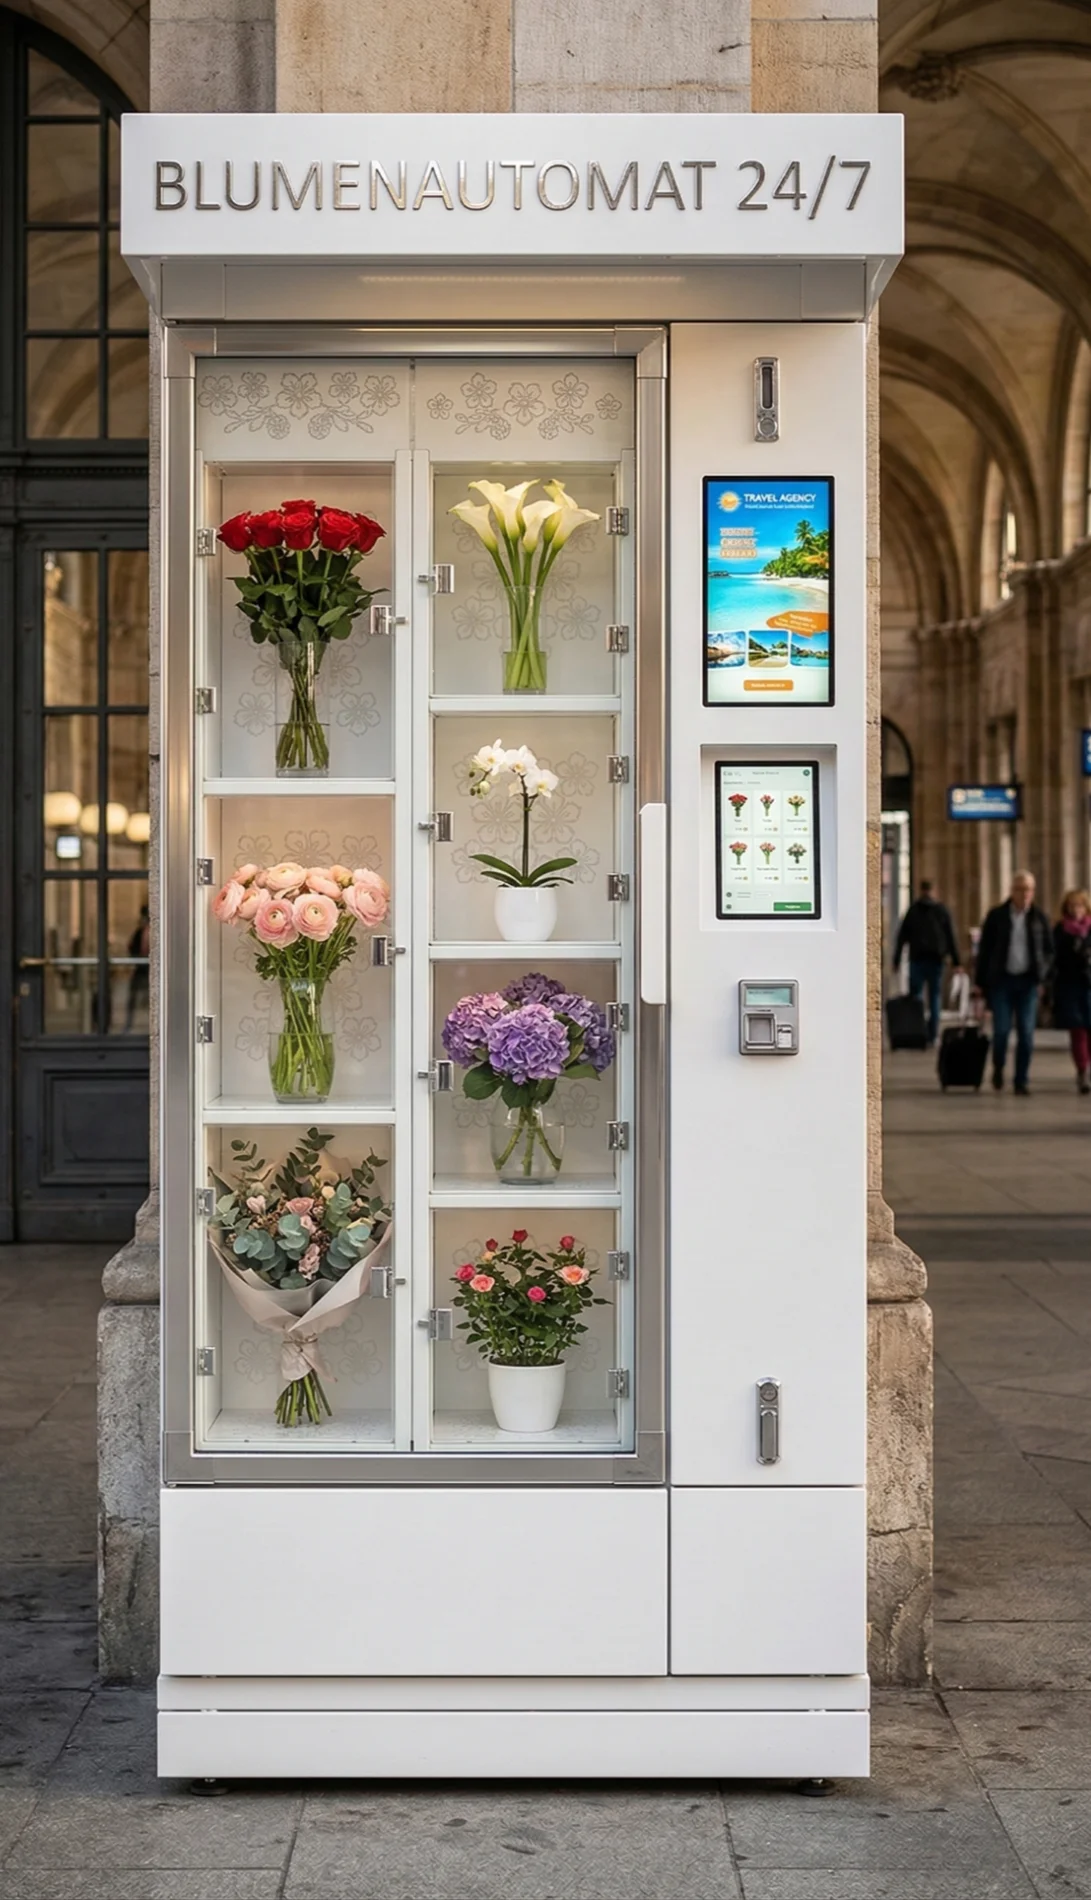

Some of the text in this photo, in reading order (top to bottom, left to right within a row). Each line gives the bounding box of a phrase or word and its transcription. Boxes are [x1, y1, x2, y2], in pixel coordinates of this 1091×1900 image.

[154, 154, 874, 220] BLUMENAUTOMAT 24/7
[744, 493, 816, 502] TRAVEL AGENCY
